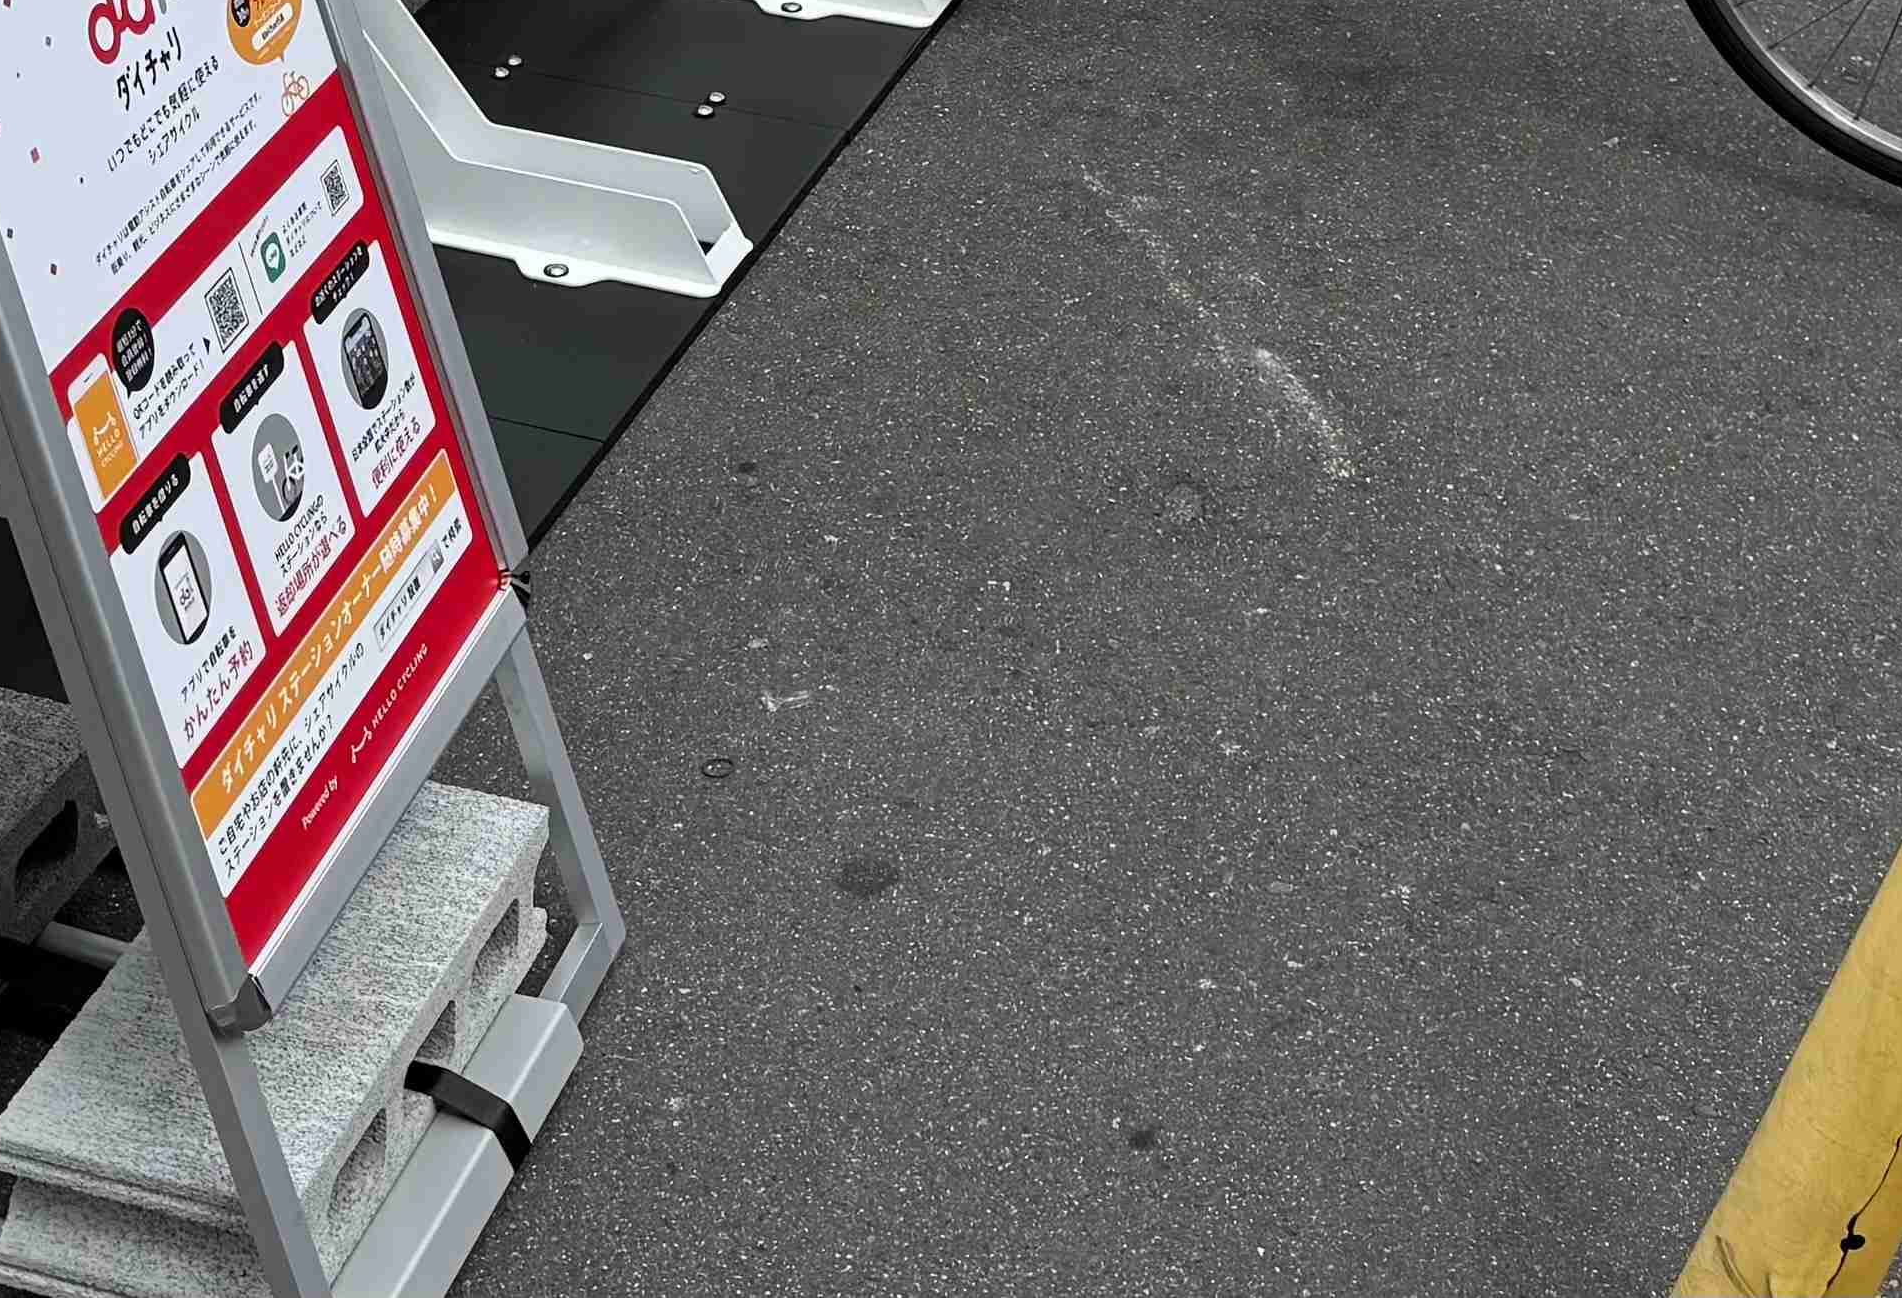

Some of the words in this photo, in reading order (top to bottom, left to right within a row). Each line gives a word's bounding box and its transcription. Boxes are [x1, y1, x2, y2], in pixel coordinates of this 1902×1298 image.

[105, 50, 220, 174] いつでもどこでも気軽に使える
[112, 23, 185, 114] ダイチャリ
[146, 101, 201, 167] シェアサイクル
[369, 412, 422, 492] 便利に使える
[273, 510, 348, 619] 返却場所が選べる
[179, 622, 237, 704] アプリで自転車を
[180, 634, 255, 744] かんたん予約
[370, 685, 398, 731] HELLO
[396, 640, 428, 693] CYCLING
[218, 701, 280, 797] ダイチャリ
[301, 783, 330, 832] Powered
[327, 770, 340, 796] by
